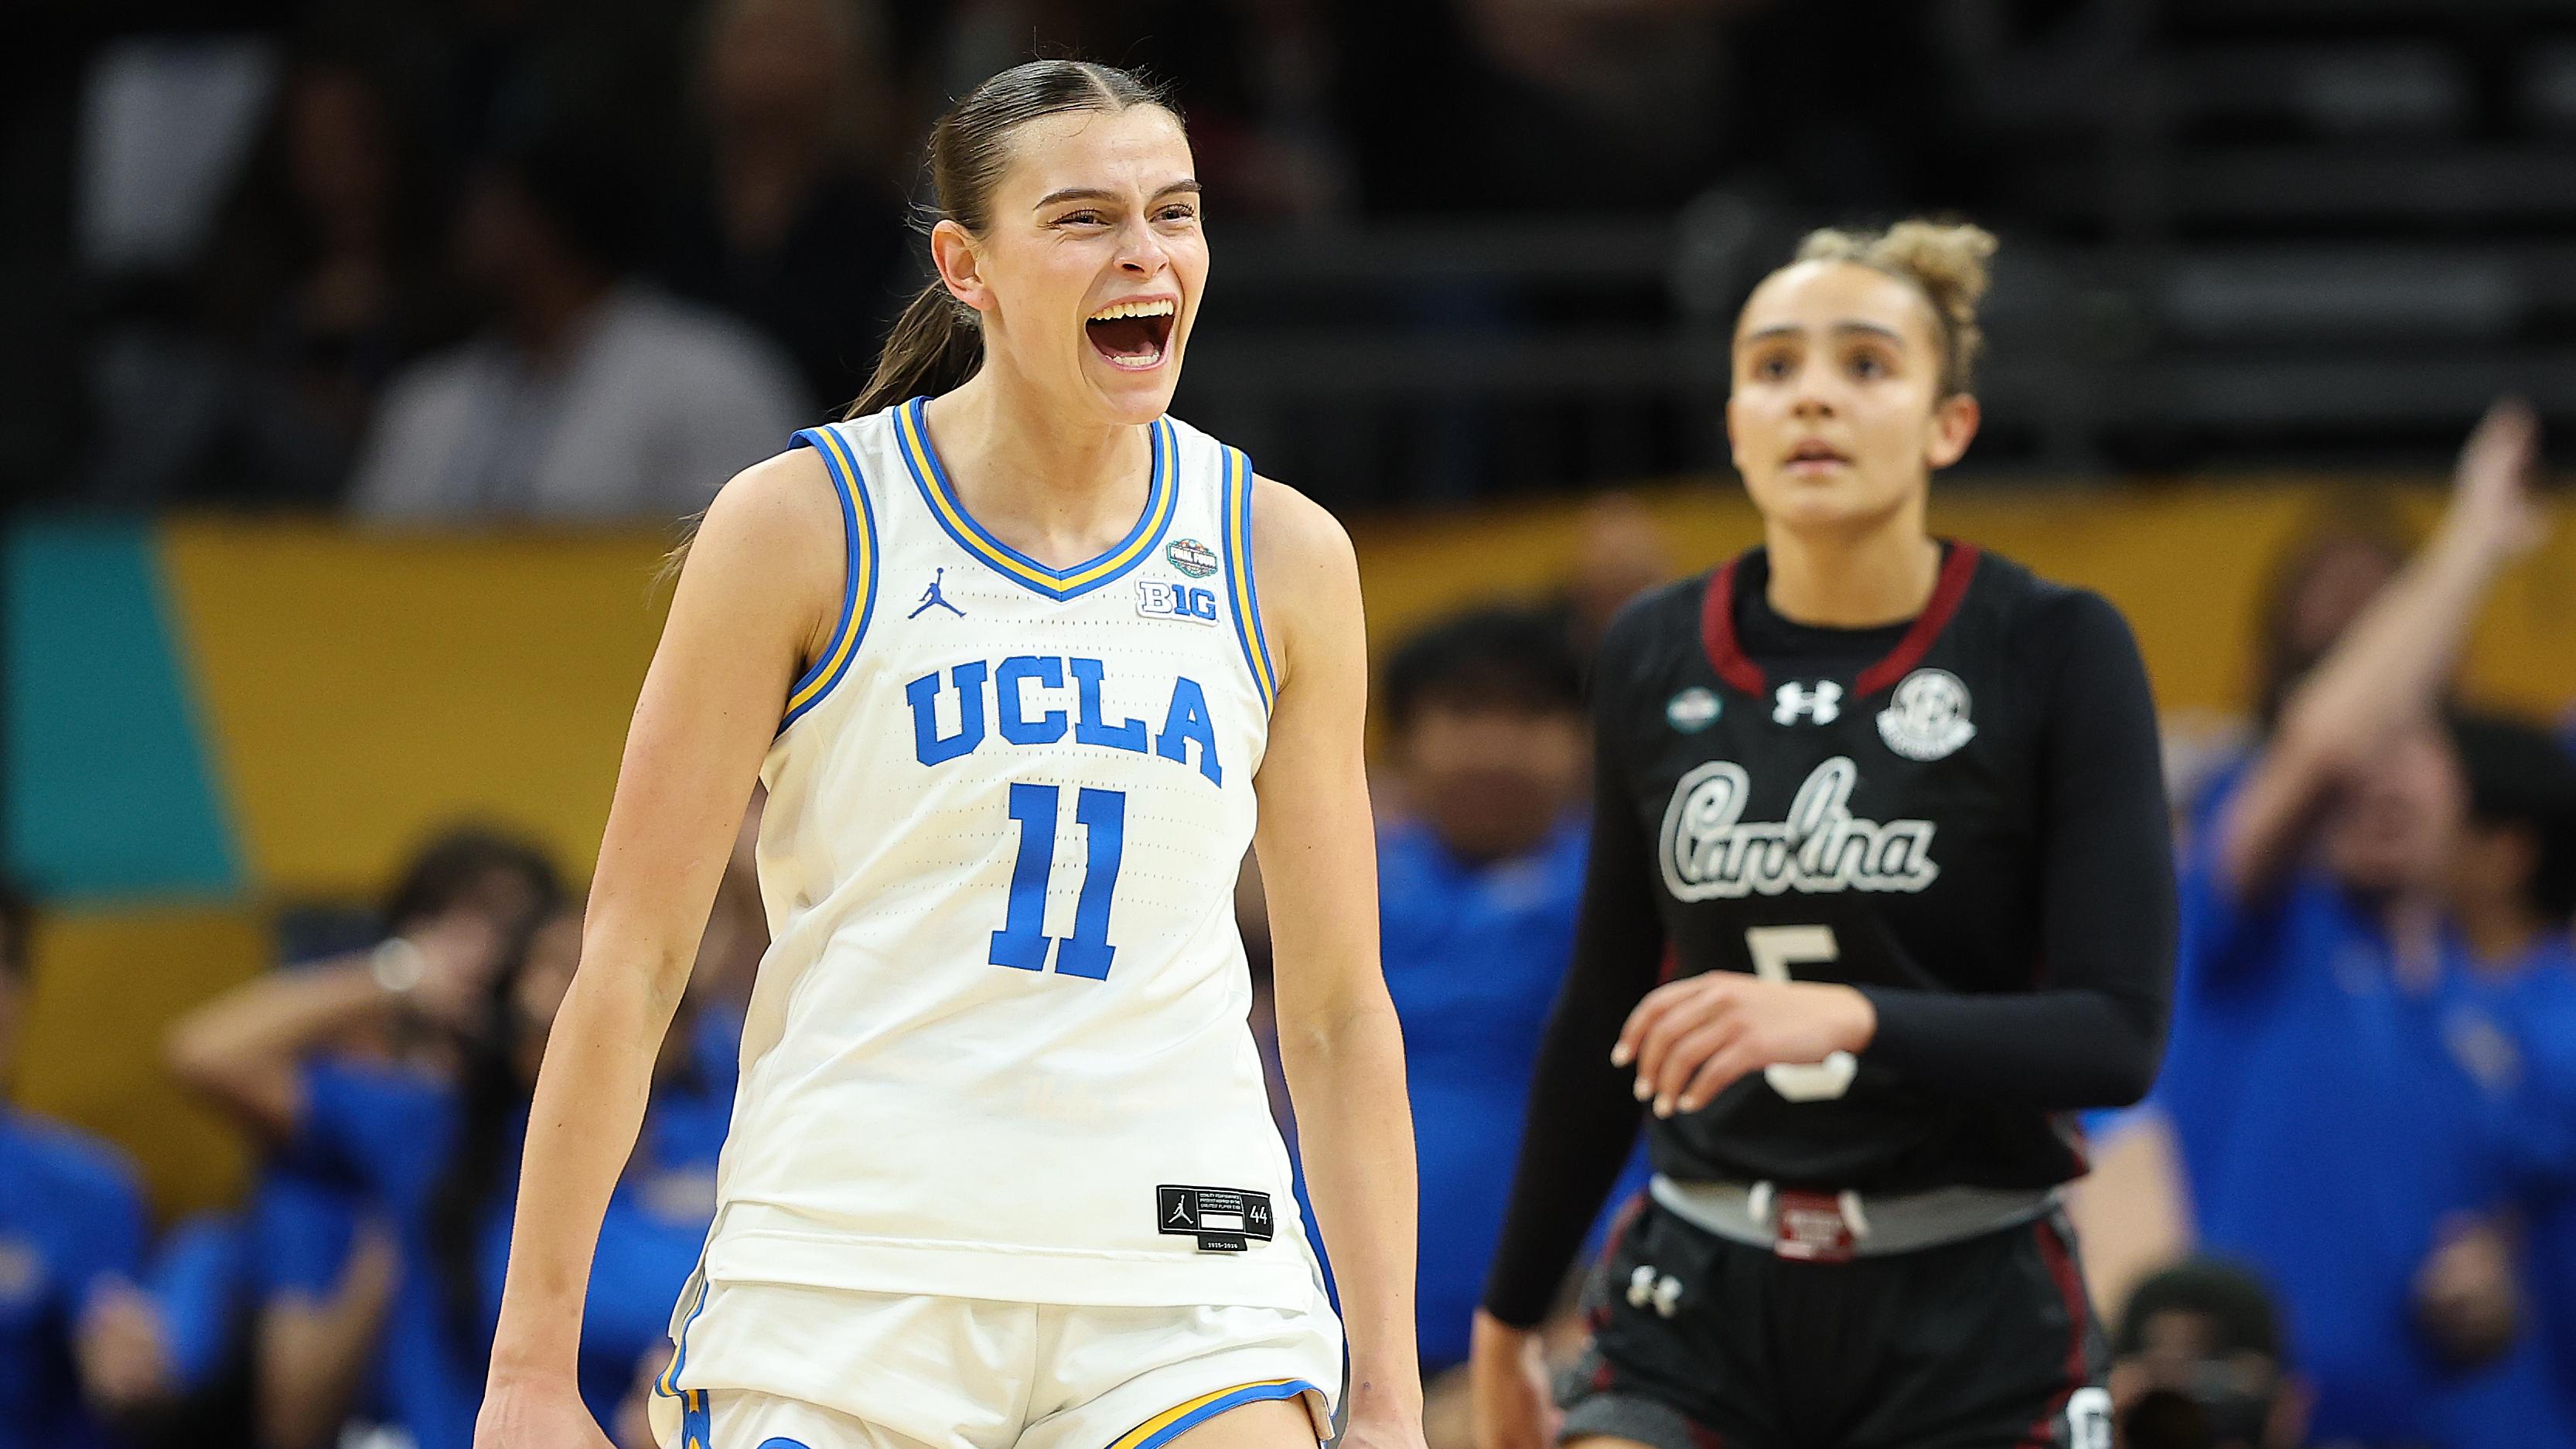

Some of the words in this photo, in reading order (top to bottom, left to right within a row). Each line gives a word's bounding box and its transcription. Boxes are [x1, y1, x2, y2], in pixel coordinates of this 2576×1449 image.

[906, 656, 1222, 789] UCLA
[988, 782, 1126, 981] 11
[1659, 755, 1940, 903] Carolina
[1745, 925, 1857, 1103] 5
[1249, 1205, 1268, 1225] 44
